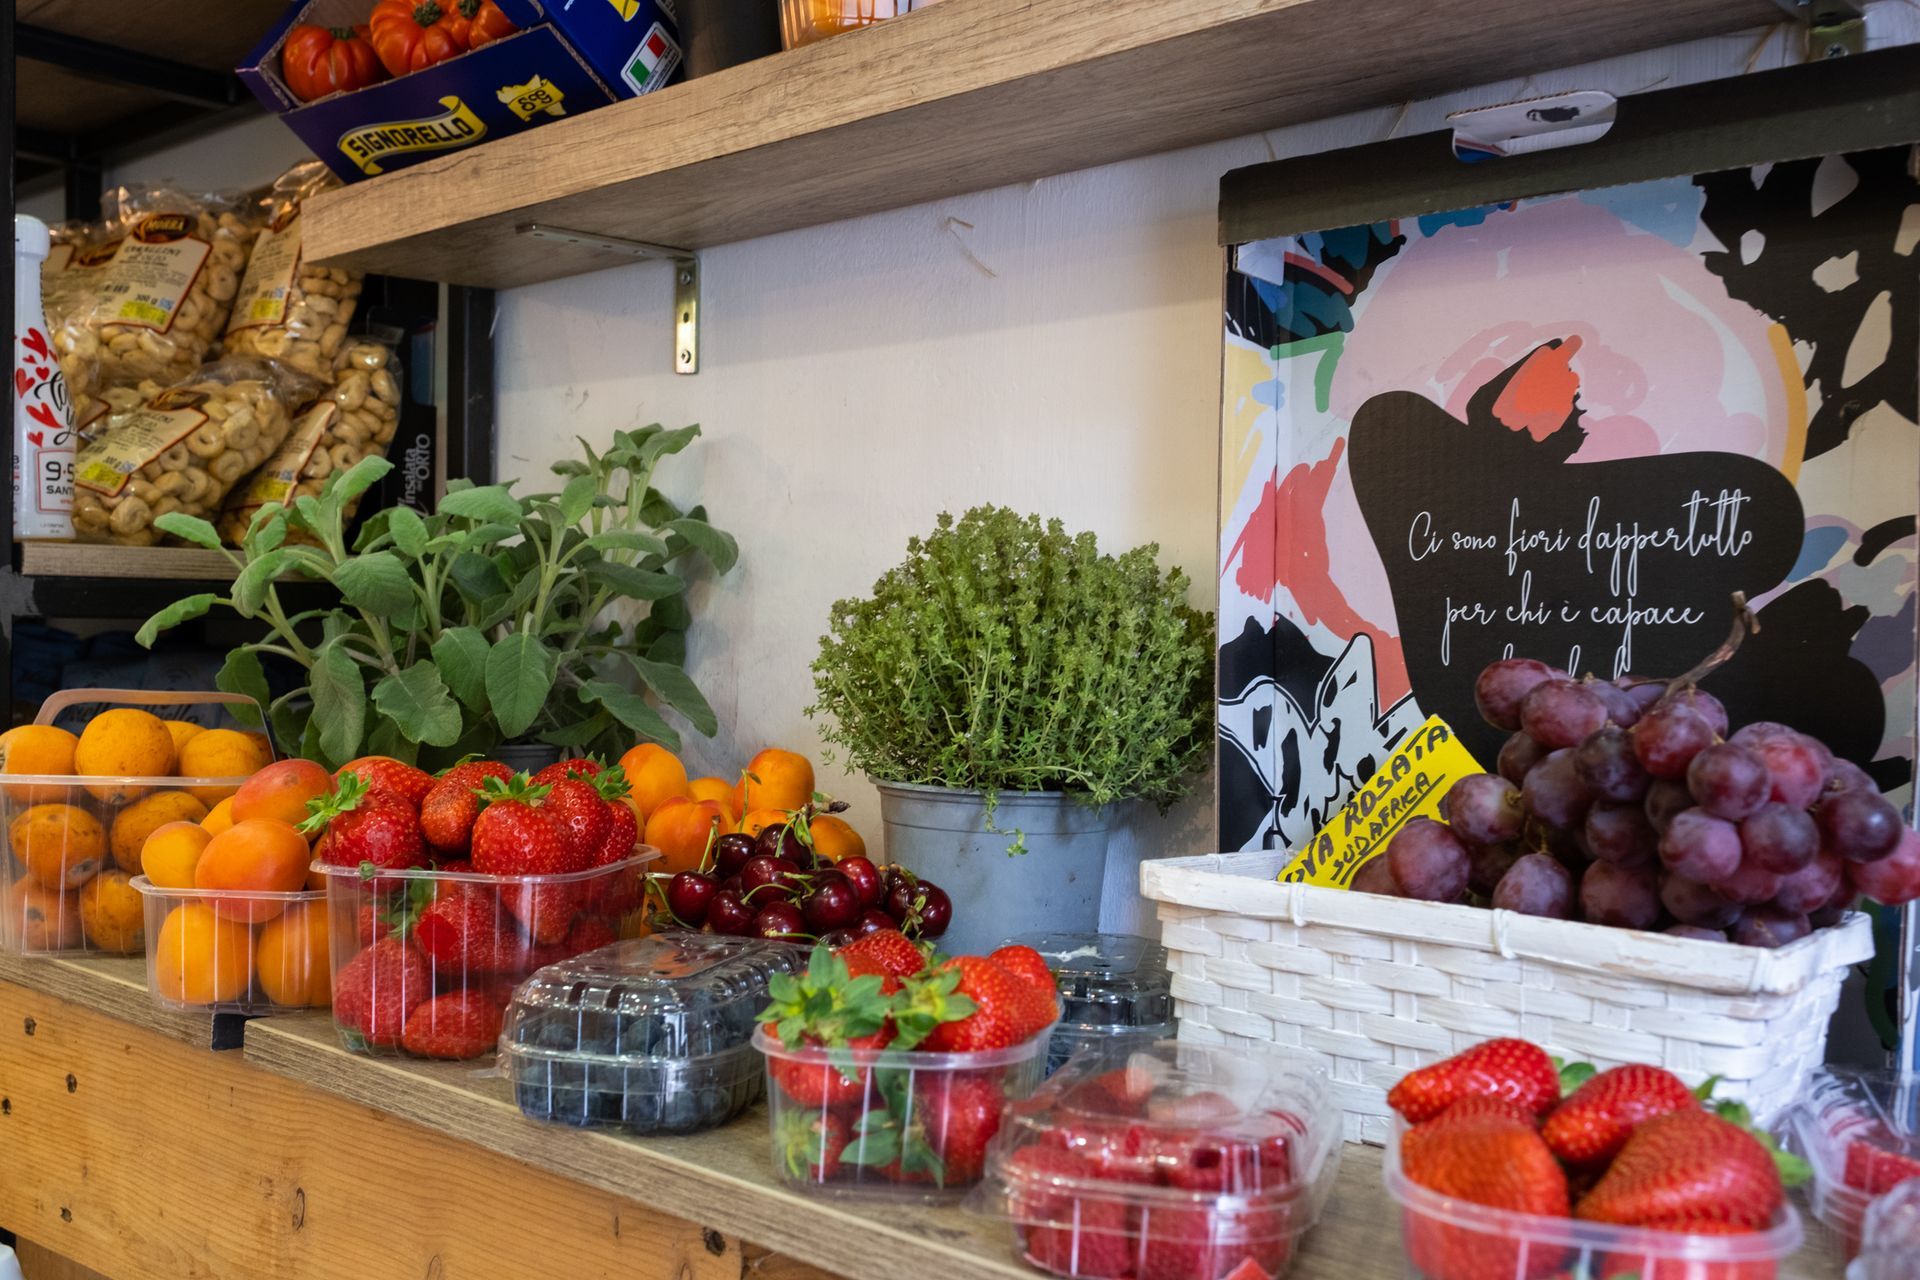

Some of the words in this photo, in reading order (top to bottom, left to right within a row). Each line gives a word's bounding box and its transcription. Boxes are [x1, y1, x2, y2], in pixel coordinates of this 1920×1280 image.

[347, 117, 475, 158] SIGNORELLO
[46, 485, 75, 496] SANT
[1408, 511, 1443, 561] Ci
[1452, 527, 1497, 551] sono
[1505, 497, 1571, 577] fiori
[1577, 488, 1754, 598] dappertutto
[1441, 596, 1497, 667] per
[1505, 569, 1552, 626] chi
[1590, 598, 1705, 673] capace
[1344, 725, 1449, 837] ROSATA
